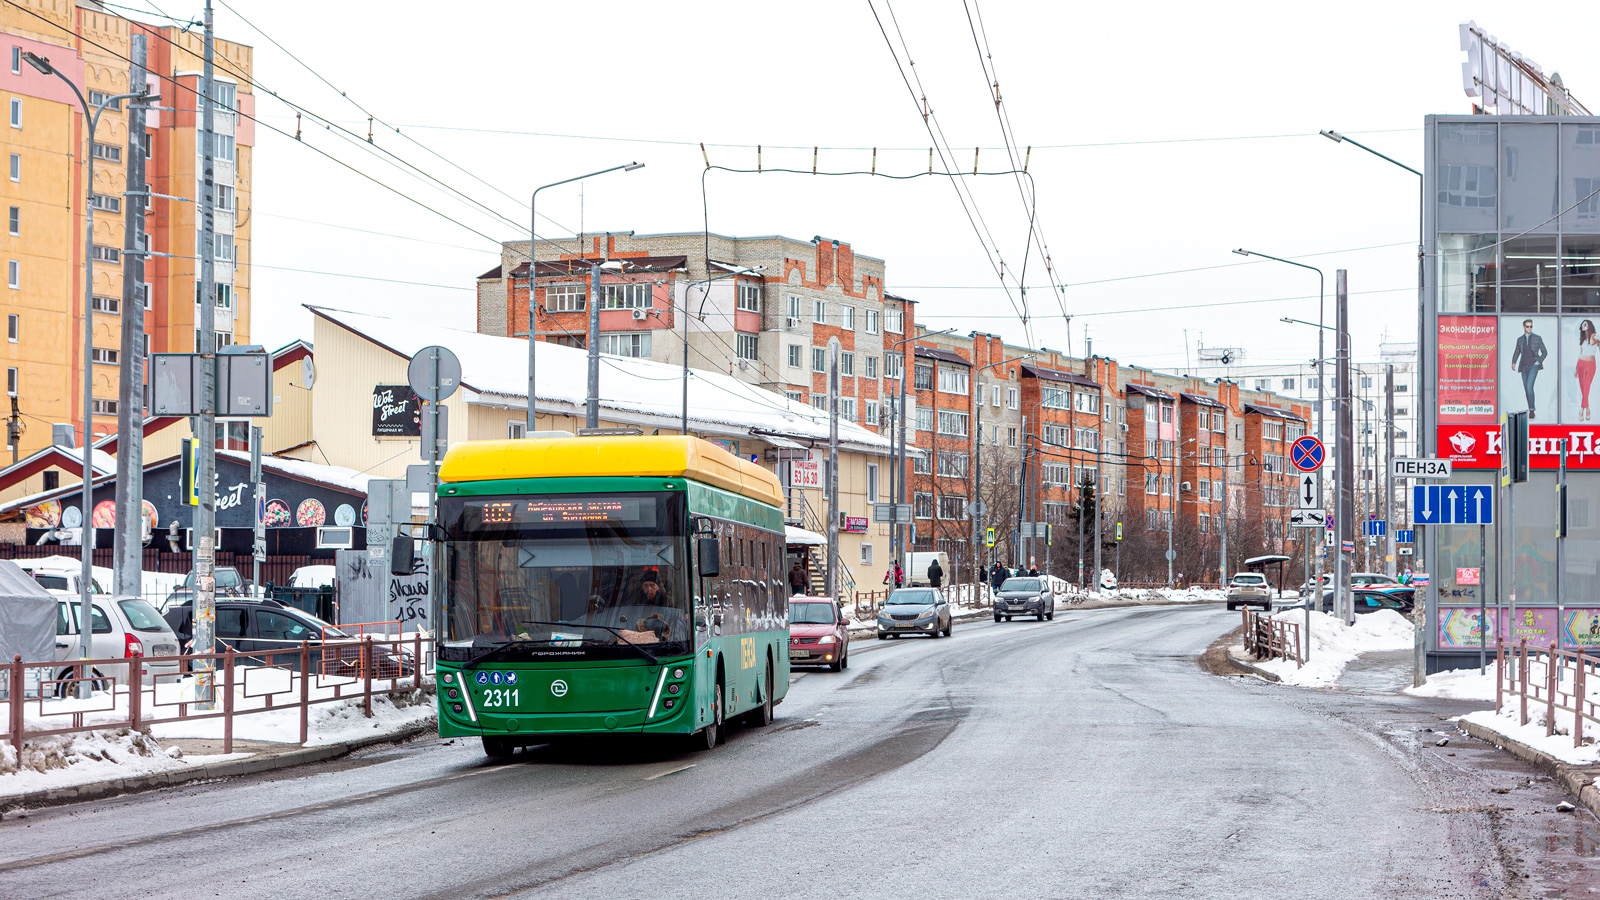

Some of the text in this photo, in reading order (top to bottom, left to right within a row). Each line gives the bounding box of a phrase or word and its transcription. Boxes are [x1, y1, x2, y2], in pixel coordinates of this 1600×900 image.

[1440, 325, 1495, 335] ЭконоМаркет
[374, 390, 393, 408] Wok
[381, 400, 409, 421] Street
[1395, 462, 1448, 474] ПЕНЗА
[795, 470, 801, 483] 53
[811, 472, 818, 485] 30
[483, 502, 512, 522] 105
[741, 637, 756, 670] ПЕНЗА
[483, 689, 519, 707] 2311
